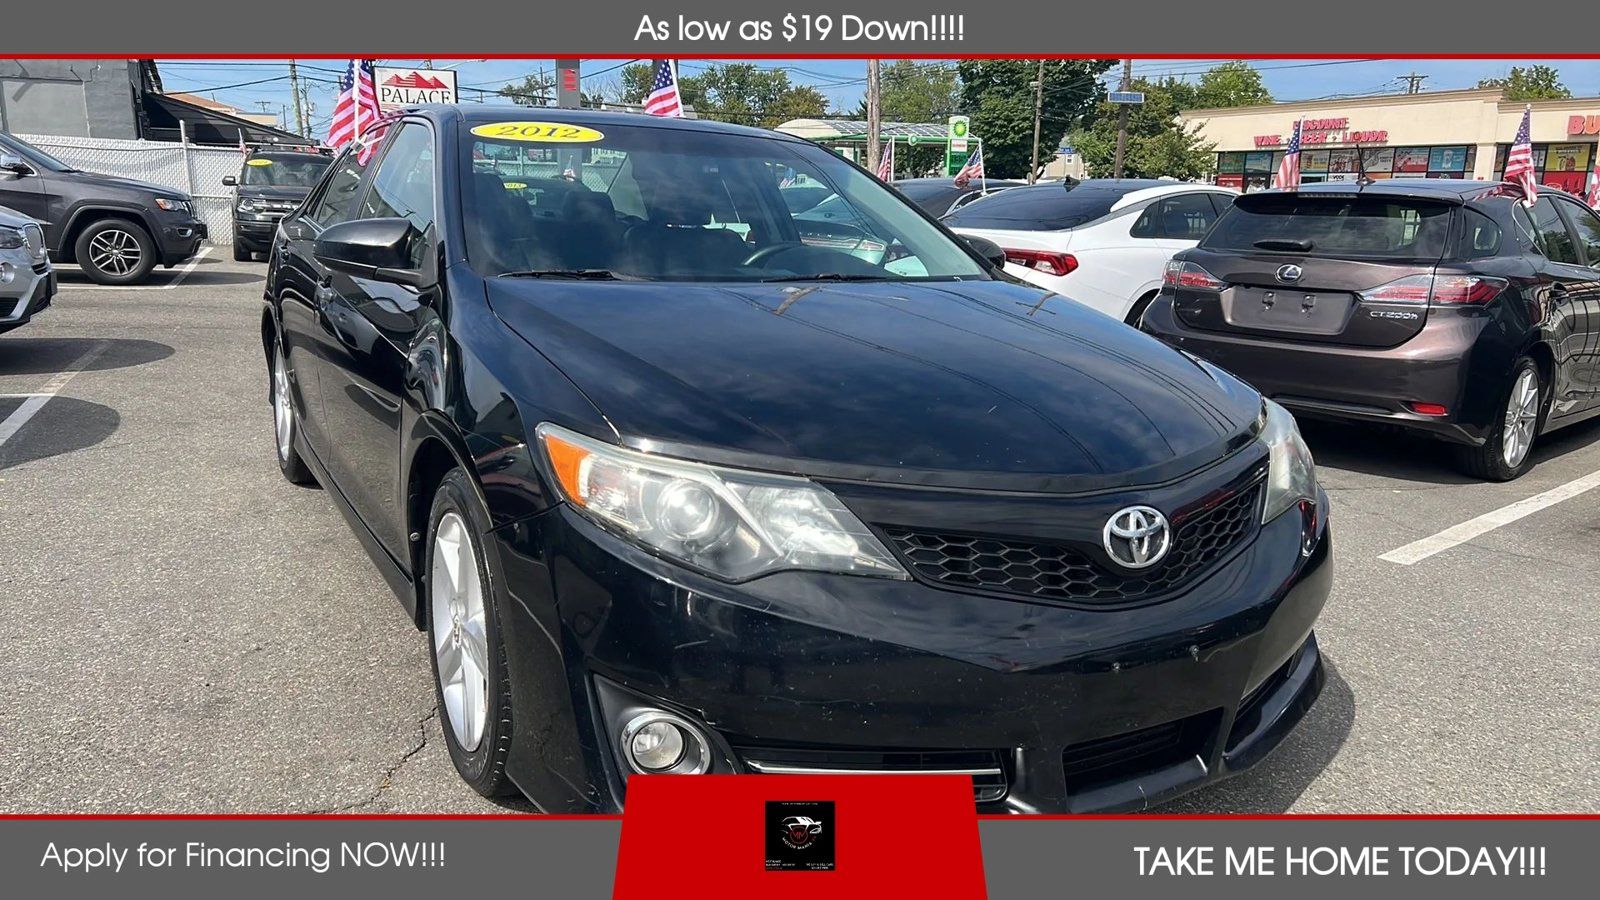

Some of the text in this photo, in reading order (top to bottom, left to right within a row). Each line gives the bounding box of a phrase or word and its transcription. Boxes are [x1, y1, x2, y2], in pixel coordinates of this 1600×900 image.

[381, 88, 451, 104] PALACE
[496, 126, 581, 138] 2012
[1254, 135, 1282, 146] WINE
[1342, 131, 1388, 143] LIQUOR
